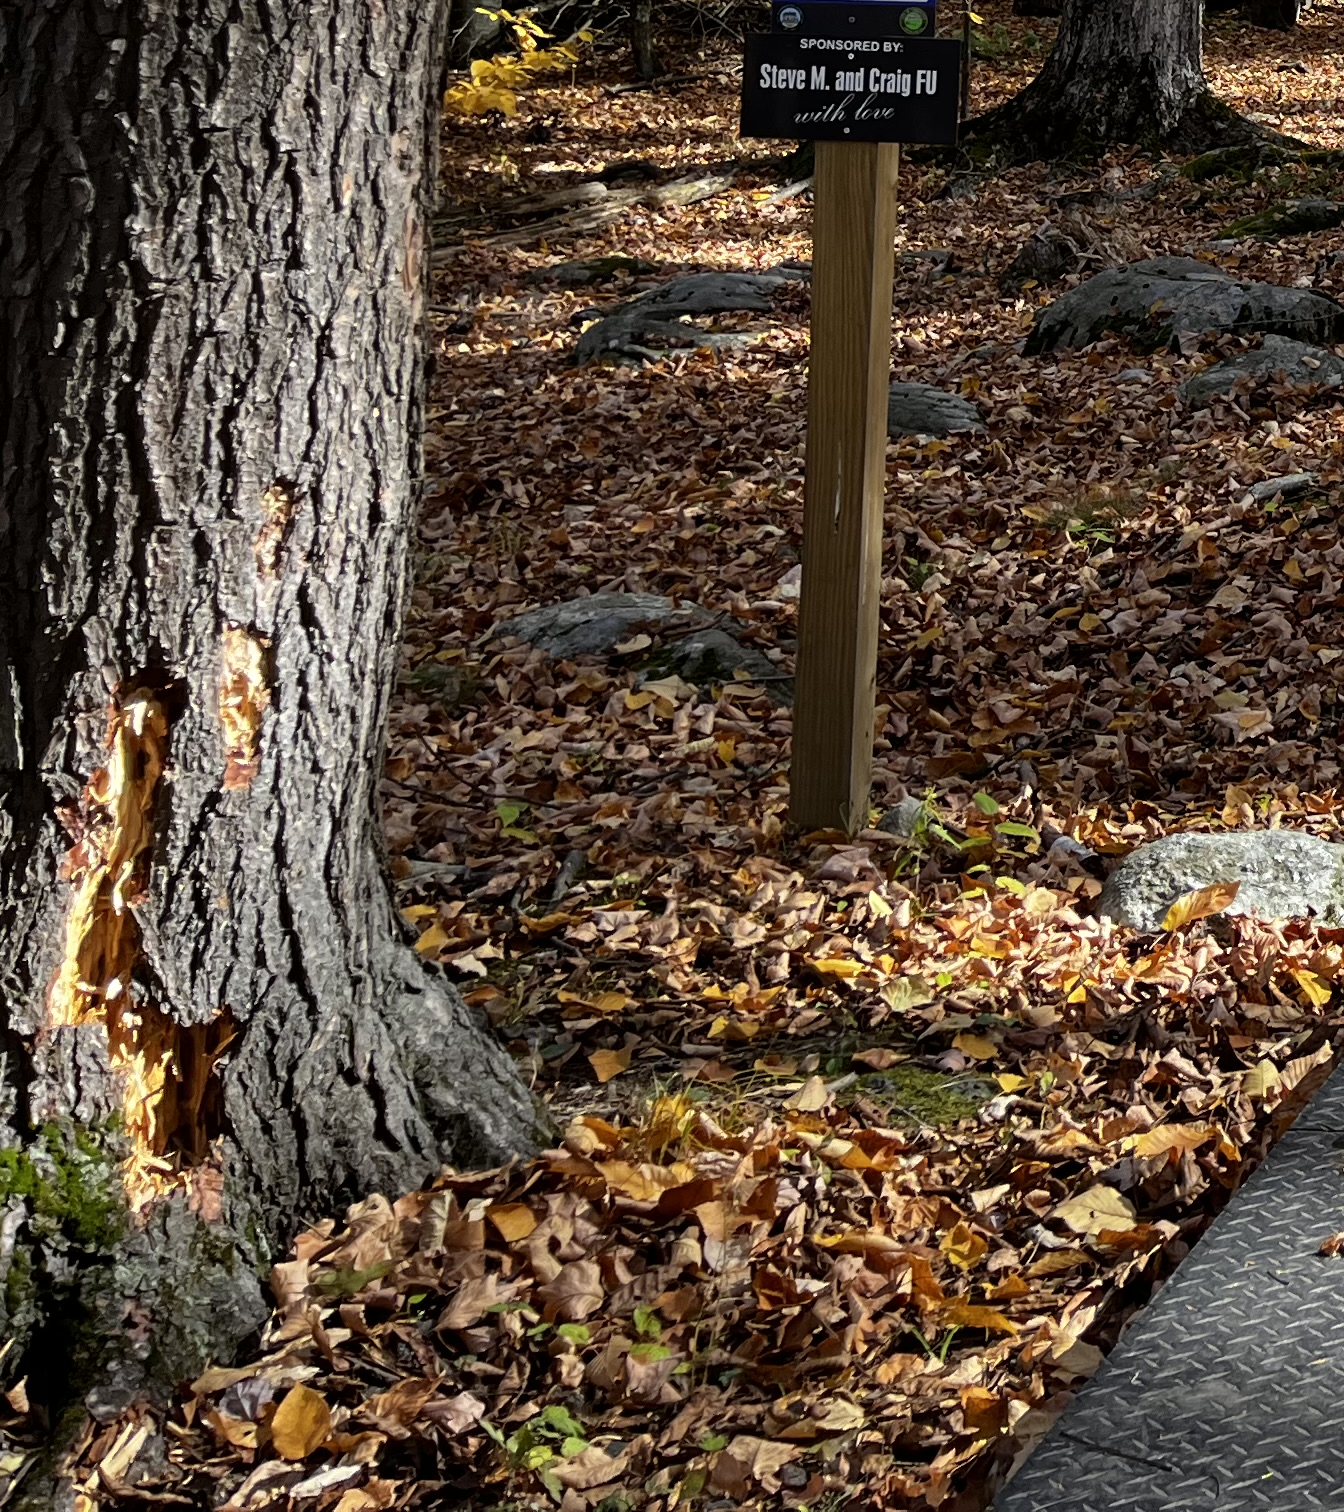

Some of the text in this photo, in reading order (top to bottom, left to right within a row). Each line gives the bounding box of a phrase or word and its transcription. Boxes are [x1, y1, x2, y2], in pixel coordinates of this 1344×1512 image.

[800, 38, 904, 53] SPONSORED BY:
[759, 63, 938, 97] Steve M. and Craig FU
[793, 92, 896, 124] with love
